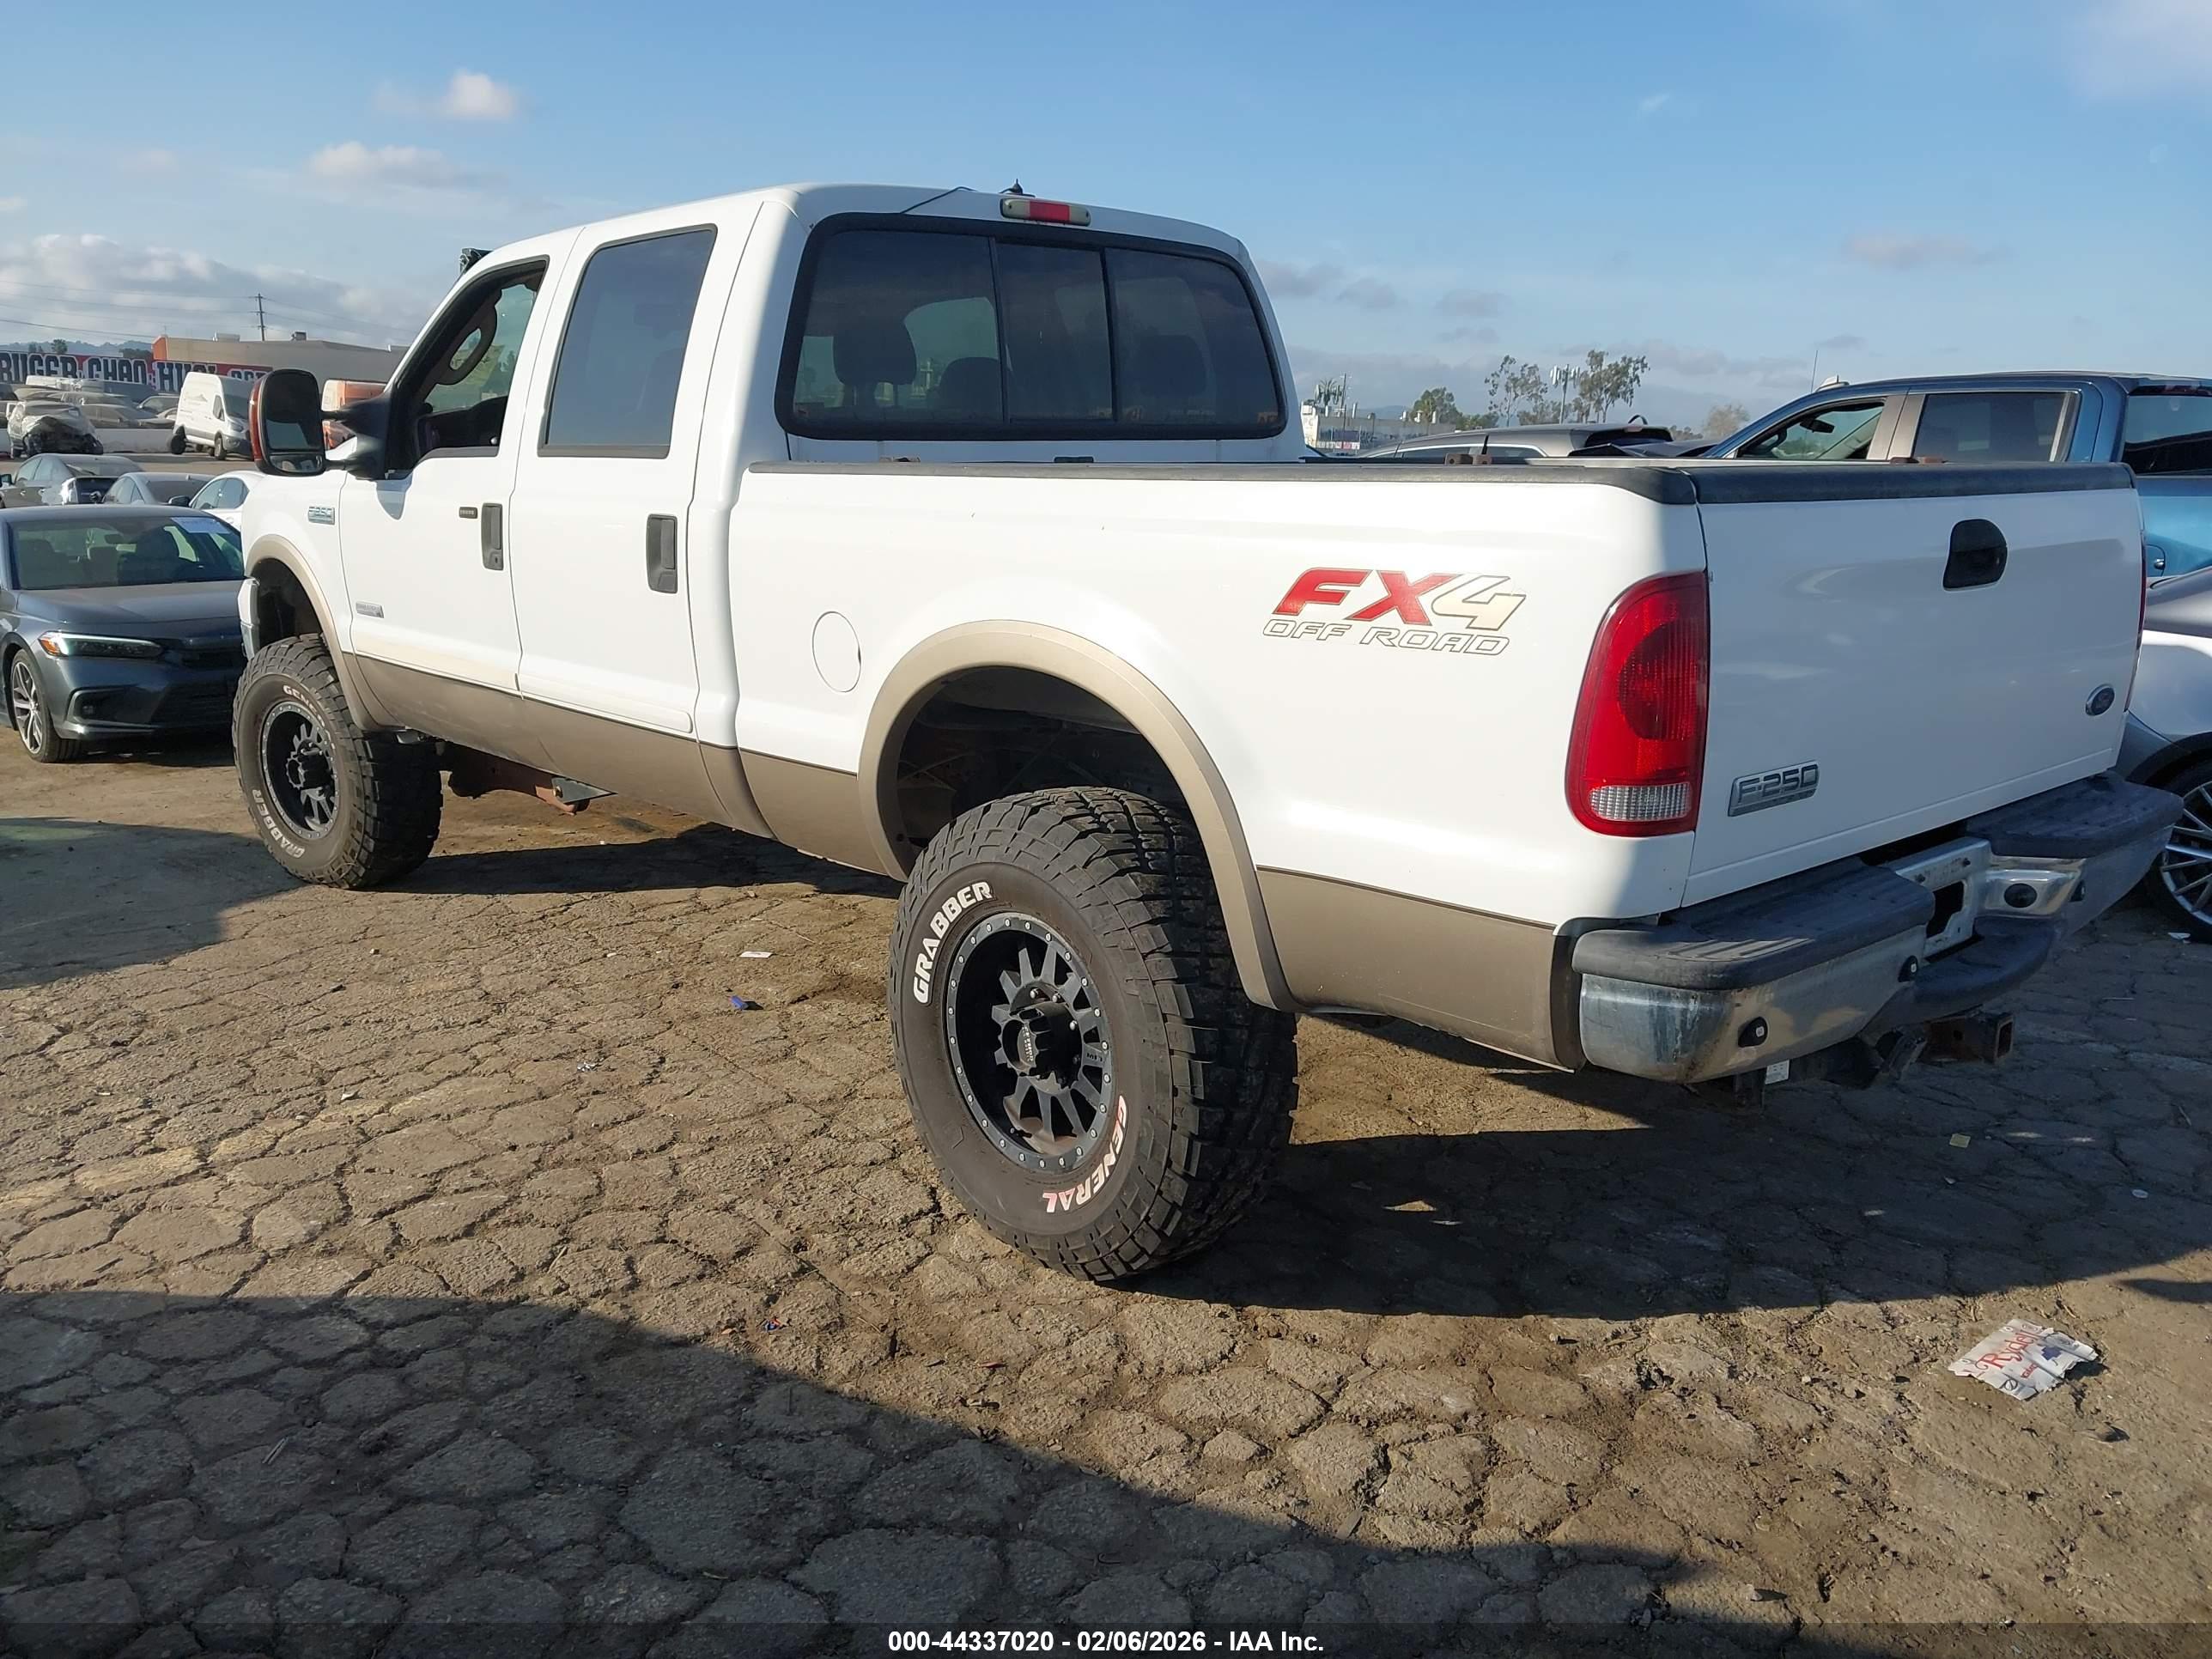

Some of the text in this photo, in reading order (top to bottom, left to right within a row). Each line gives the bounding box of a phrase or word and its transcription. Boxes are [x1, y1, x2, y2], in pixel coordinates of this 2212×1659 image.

[1272, 567, 1527, 631] FX4
[1262, 618, 1510, 656] OFF ROAD
[252, 789, 306, 859] GRABBER
[913, 880, 994, 1005] GRABBER
[1042, 1095, 1128, 1213] GENERAL
